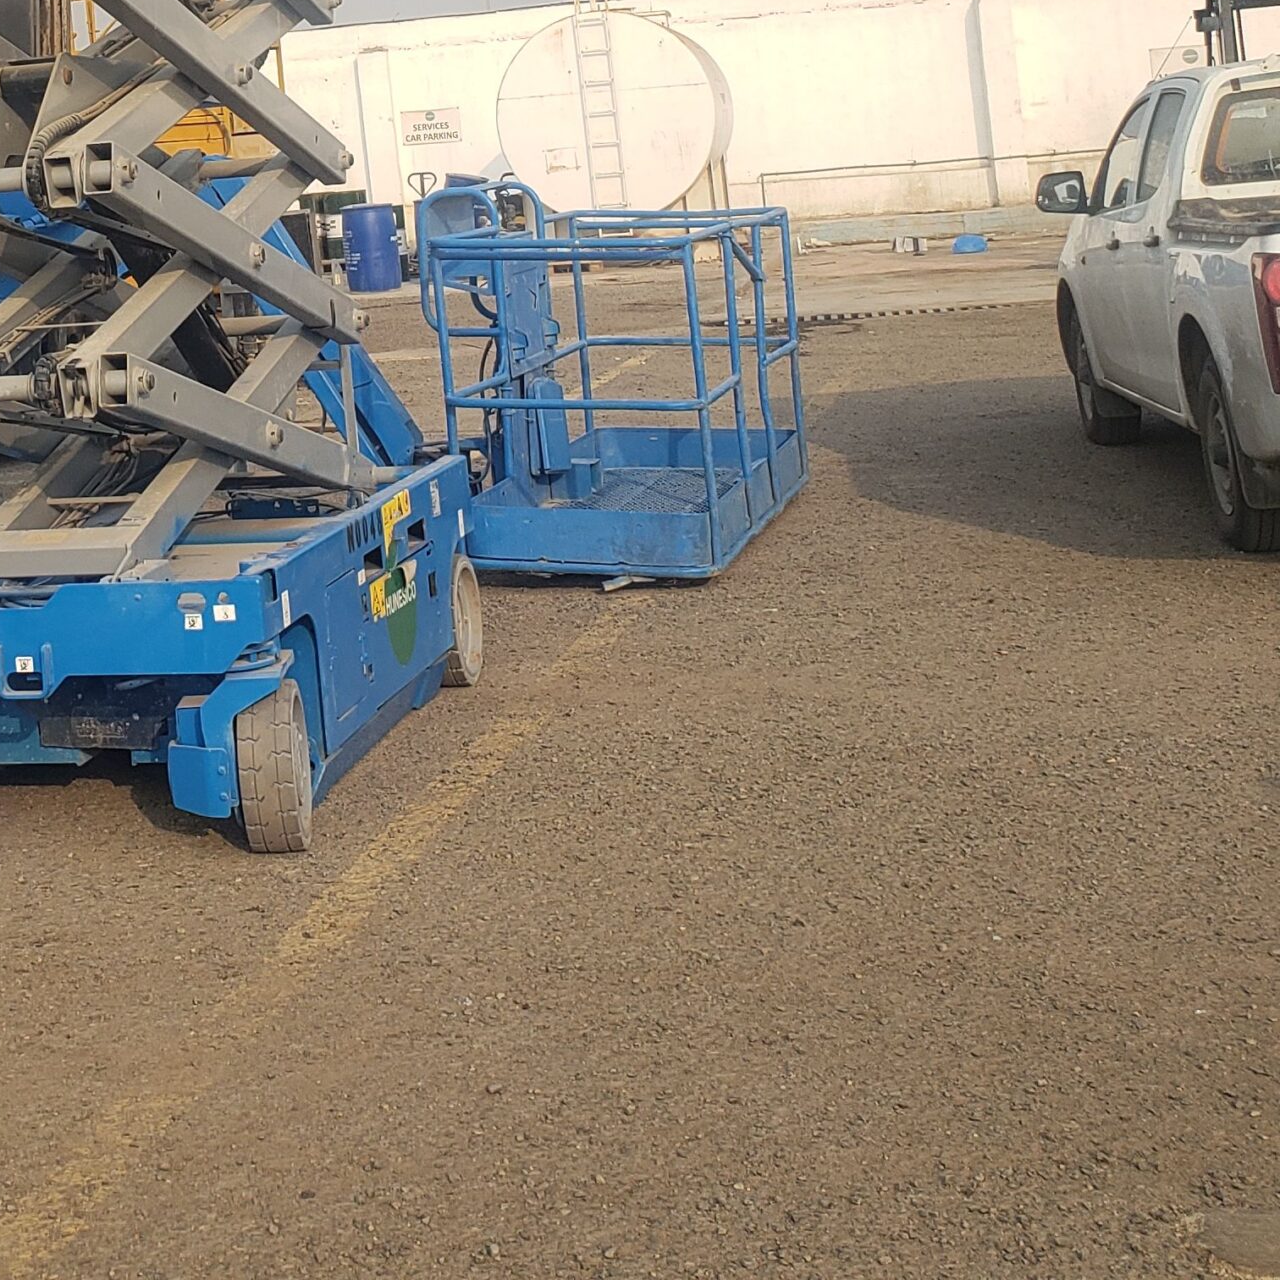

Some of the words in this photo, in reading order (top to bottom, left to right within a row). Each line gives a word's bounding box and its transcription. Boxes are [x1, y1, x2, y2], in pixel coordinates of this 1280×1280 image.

[412, 121, 450, 132] SERVICES
[405, 133, 422, 143] CAR
[423, 130, 459, 141] PARKING
